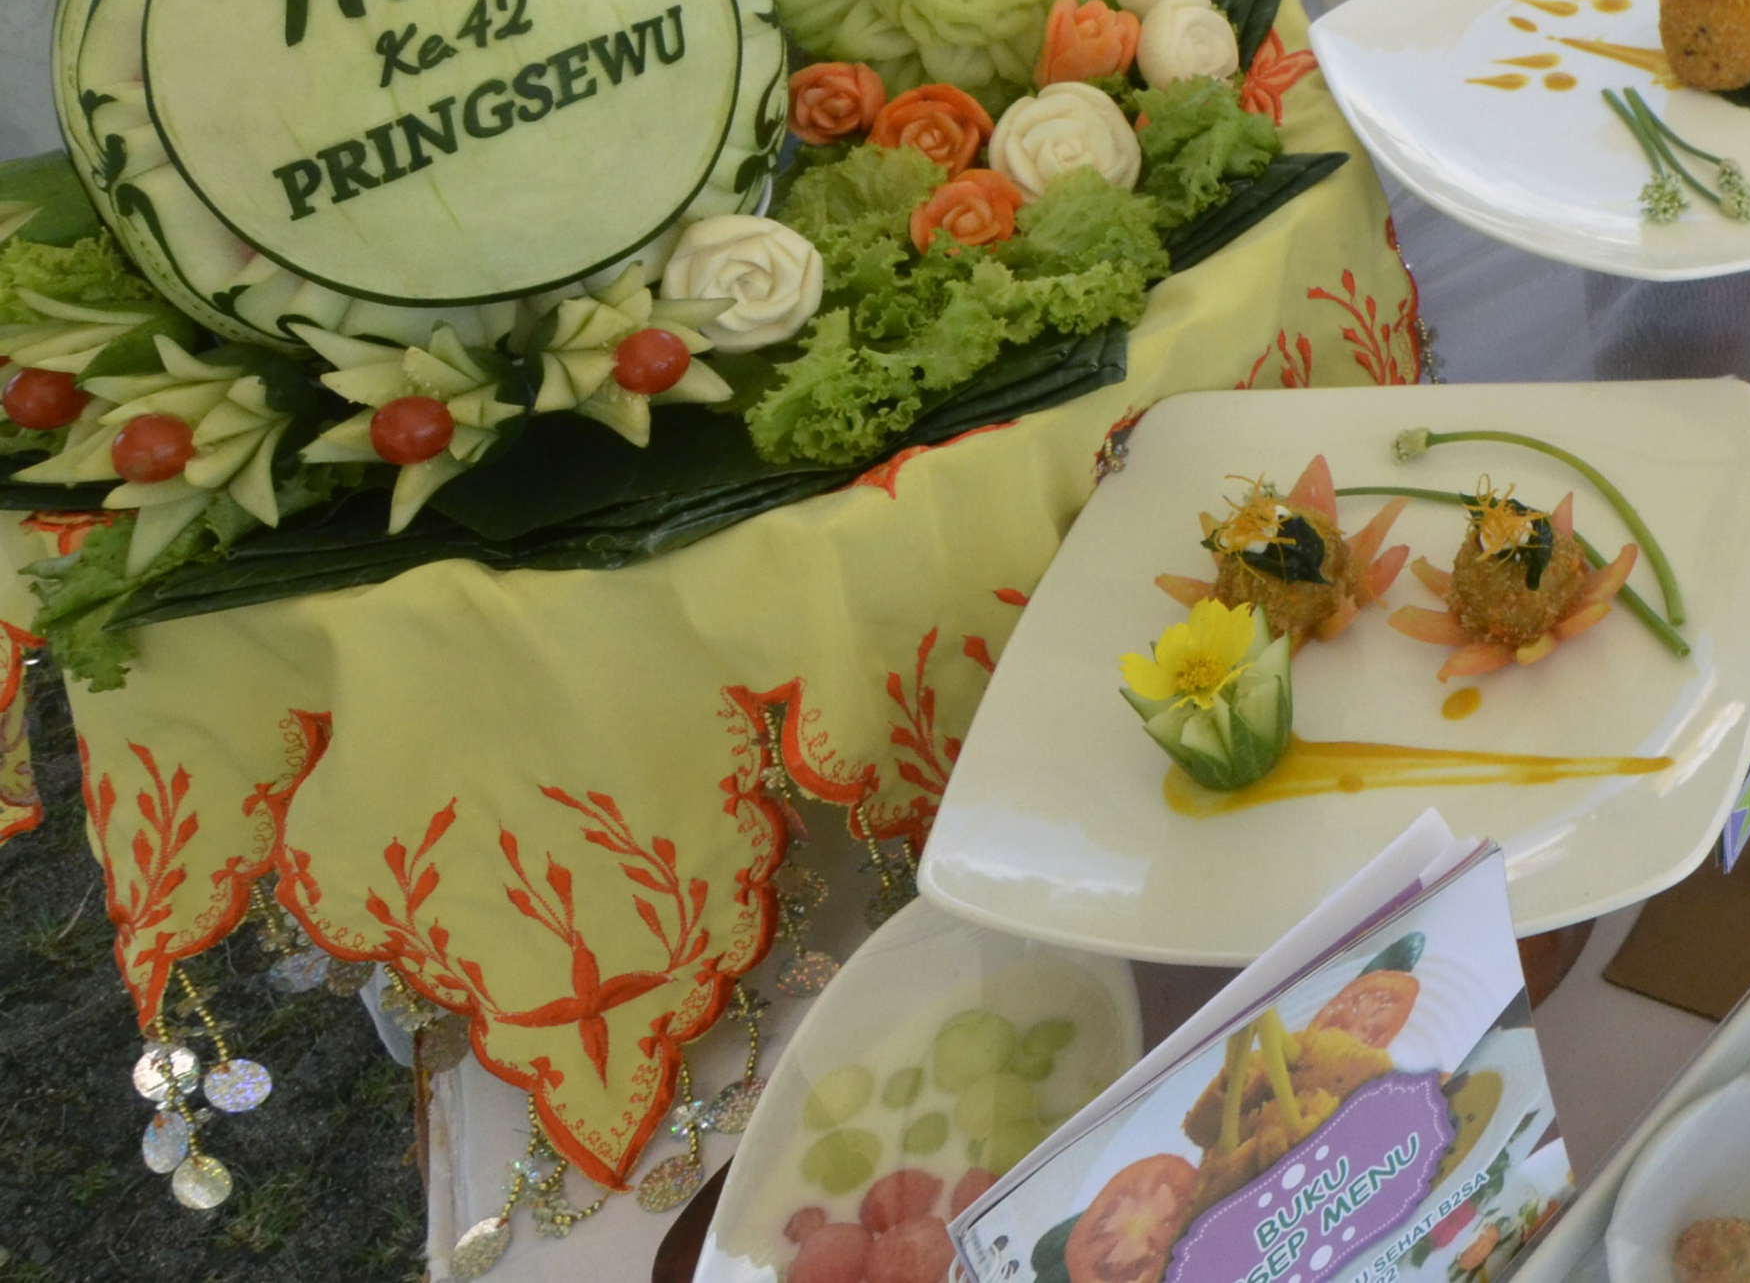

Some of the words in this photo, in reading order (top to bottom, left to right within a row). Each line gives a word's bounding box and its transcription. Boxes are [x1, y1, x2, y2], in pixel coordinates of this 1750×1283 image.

[271, 4, 686, 222] PRINGSEWU
[1237, 1229, 1308, 1283] SEP
[1321, 1132, 1419, 1234] MENU
[1255, 1156, 1348, 1251] BUKU
[1373, 1215, 1434, 1273] SEHAT
[1437, 1171, 1489, 1219] B2SA
